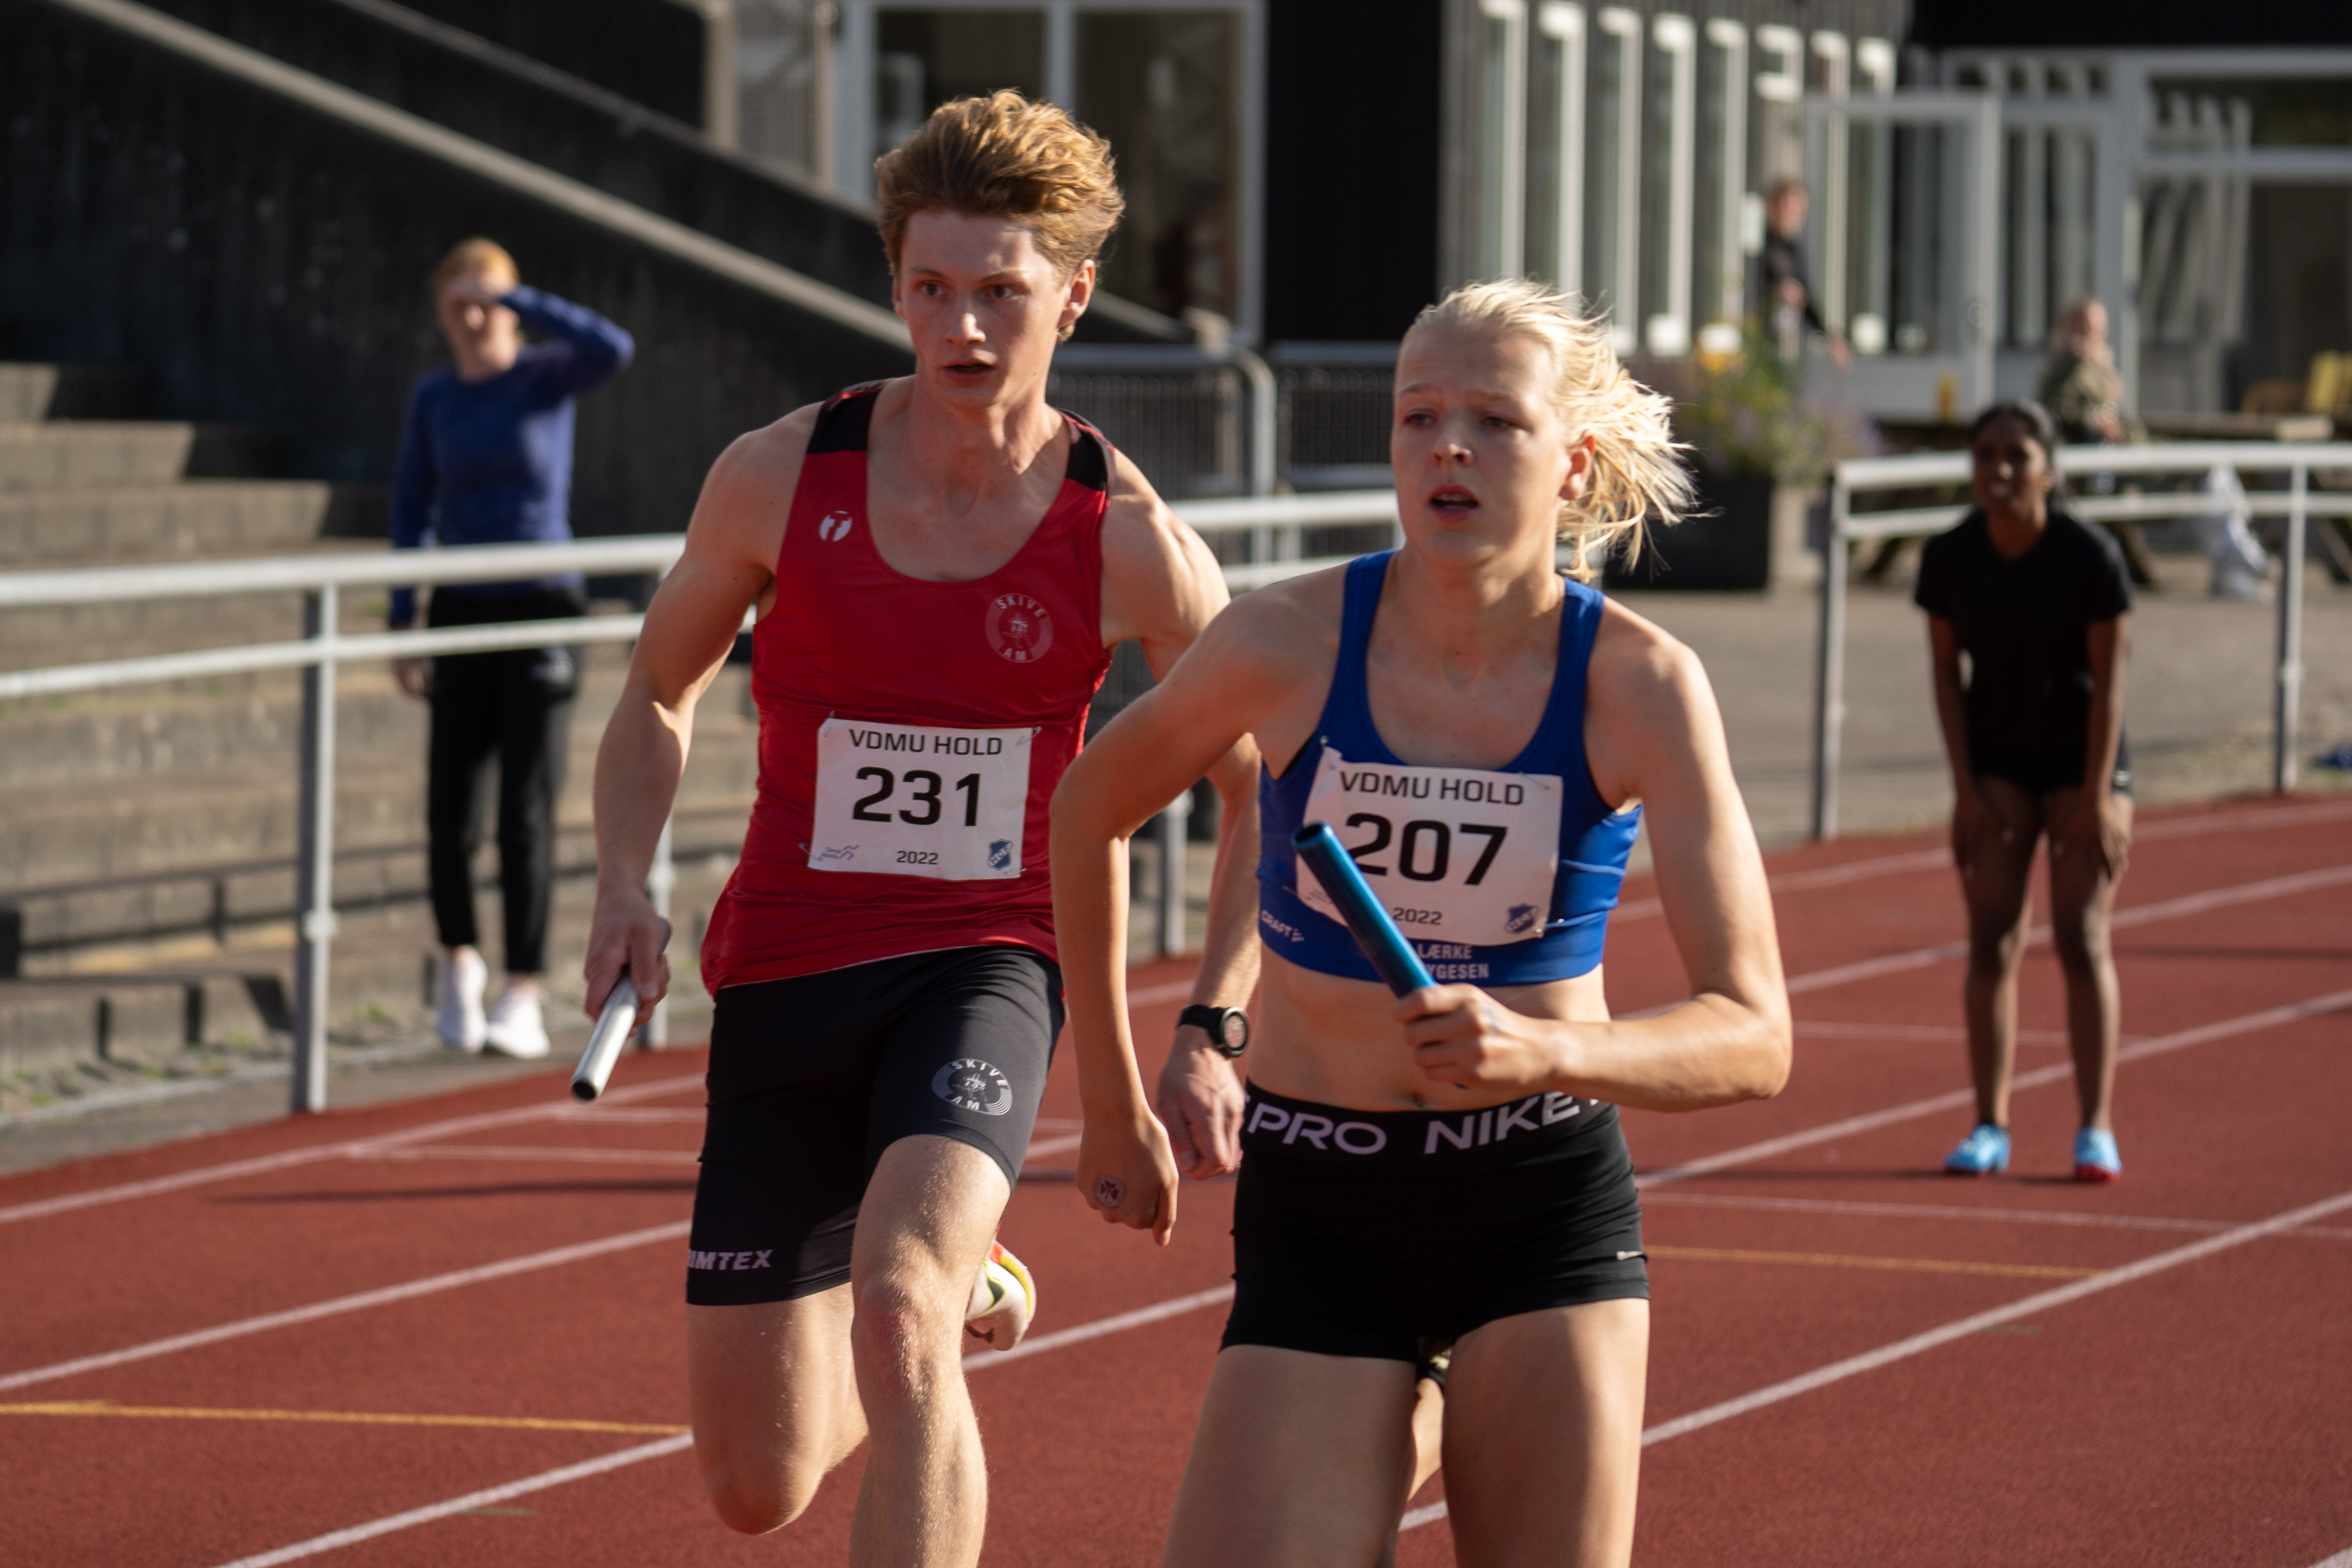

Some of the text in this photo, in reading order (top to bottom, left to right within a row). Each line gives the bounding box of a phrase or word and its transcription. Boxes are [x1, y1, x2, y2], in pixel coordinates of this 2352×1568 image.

[849, 728, 1003, 756] VDMU HOLD
[851, 765, 982, 827] 231
[1340, 770, 1524, 806] VDMU HOLD
[896, 850, 939, 865] 2022
[1345, 811, 1509, 886] 207
[1392, 907, 1443, 926] 2022
[1417, 943, 1473, 960] LÆRKE
[951, 1059, 1009, 1087] SKIVE
[950, 1095, 981, 1111] AM
[1246, 1090, 1581, 1155] PRO NIKE
